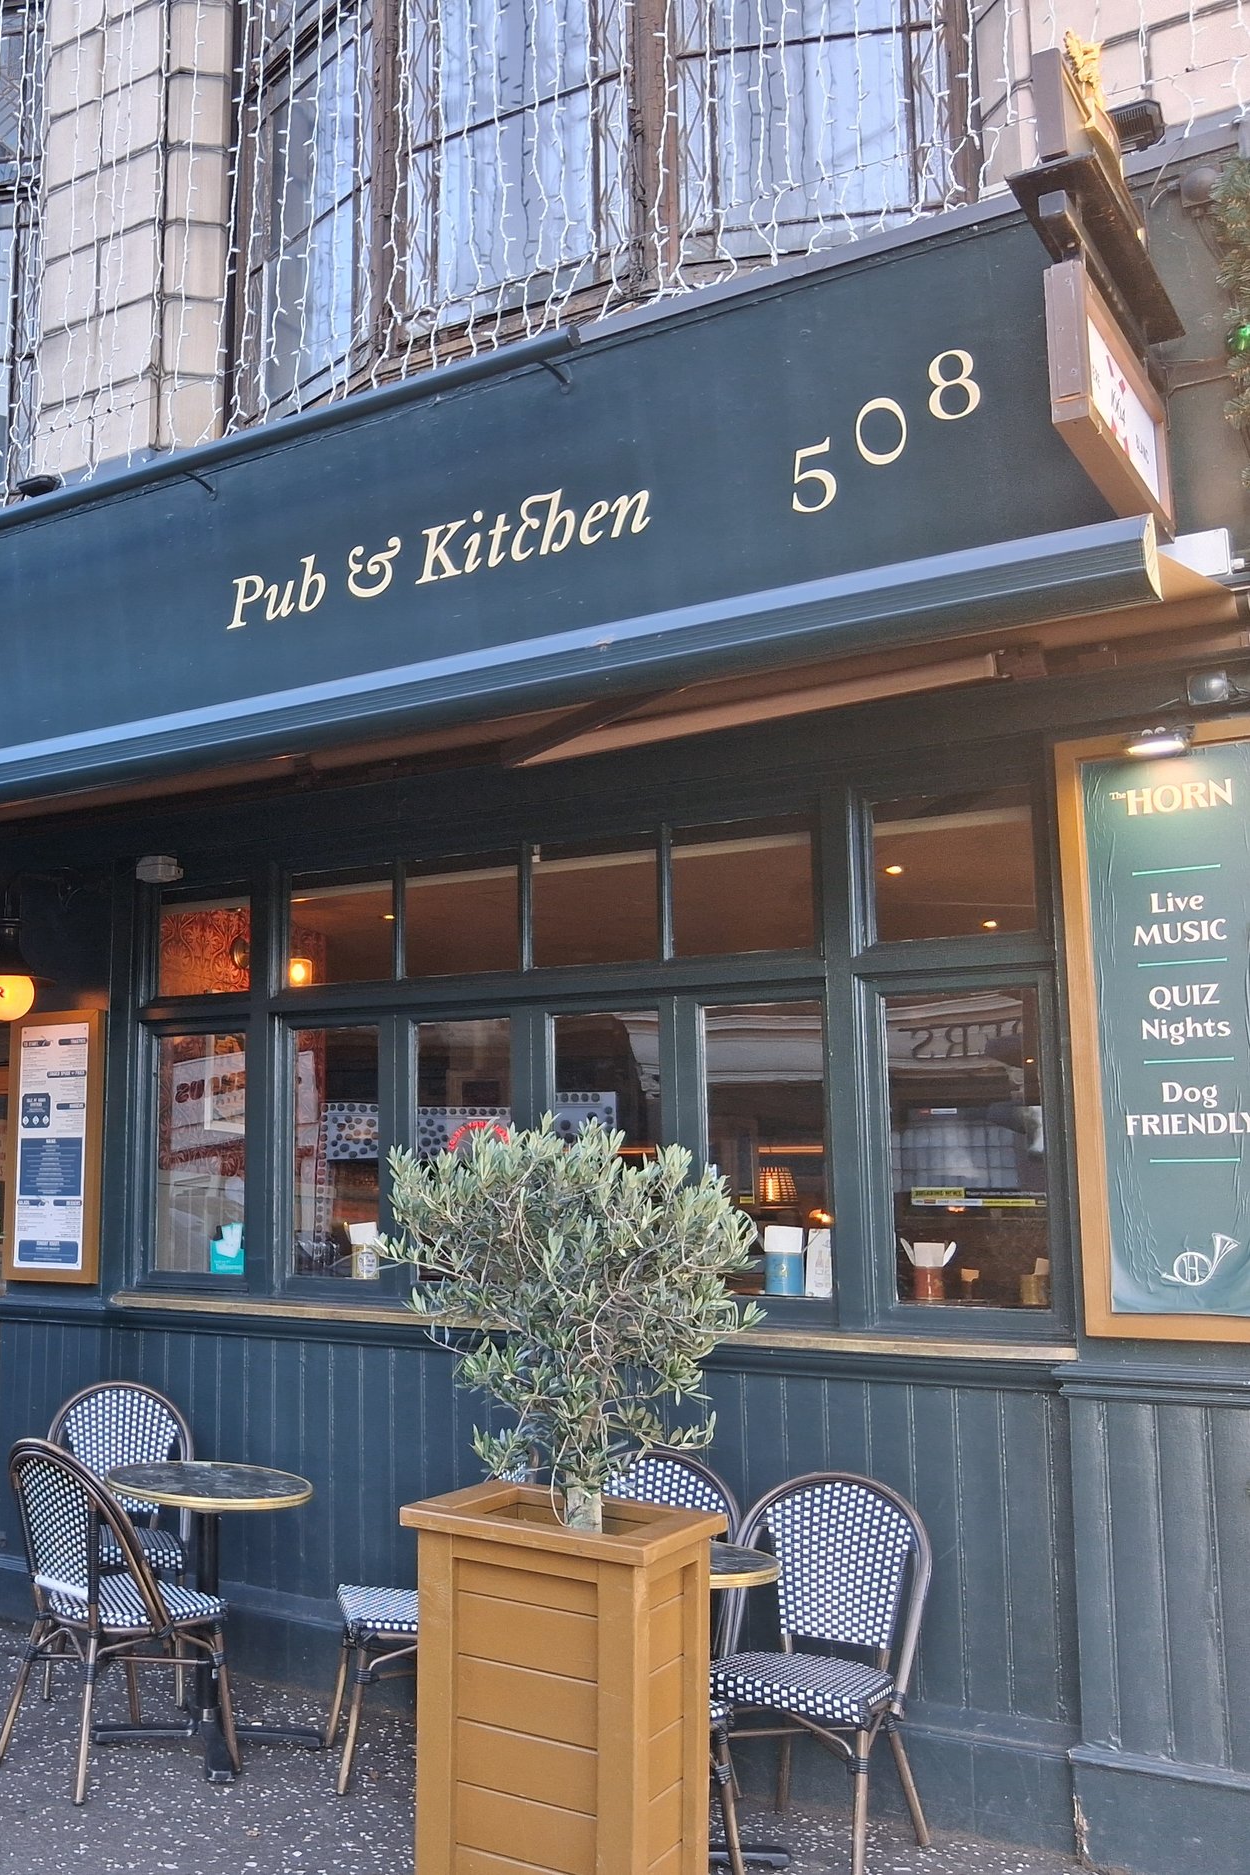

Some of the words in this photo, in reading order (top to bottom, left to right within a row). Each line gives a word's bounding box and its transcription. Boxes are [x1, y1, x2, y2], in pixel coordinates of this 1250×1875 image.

[226, 553, 327, 630] Pub
[347, 536, 401, 598] &
[415, 488, 651, 585] Kitchen
[1126, 778, 1233, 816] HORN
[1150, 892, 1204, 914] Live
[1133, 918, 1227, 946] MUSIC
[1149, 983, 1220, 1011] QUIZ
[1142, 1017, 1231, 1046] Nights
[1161, 1082, 1219, 1109] Dog
